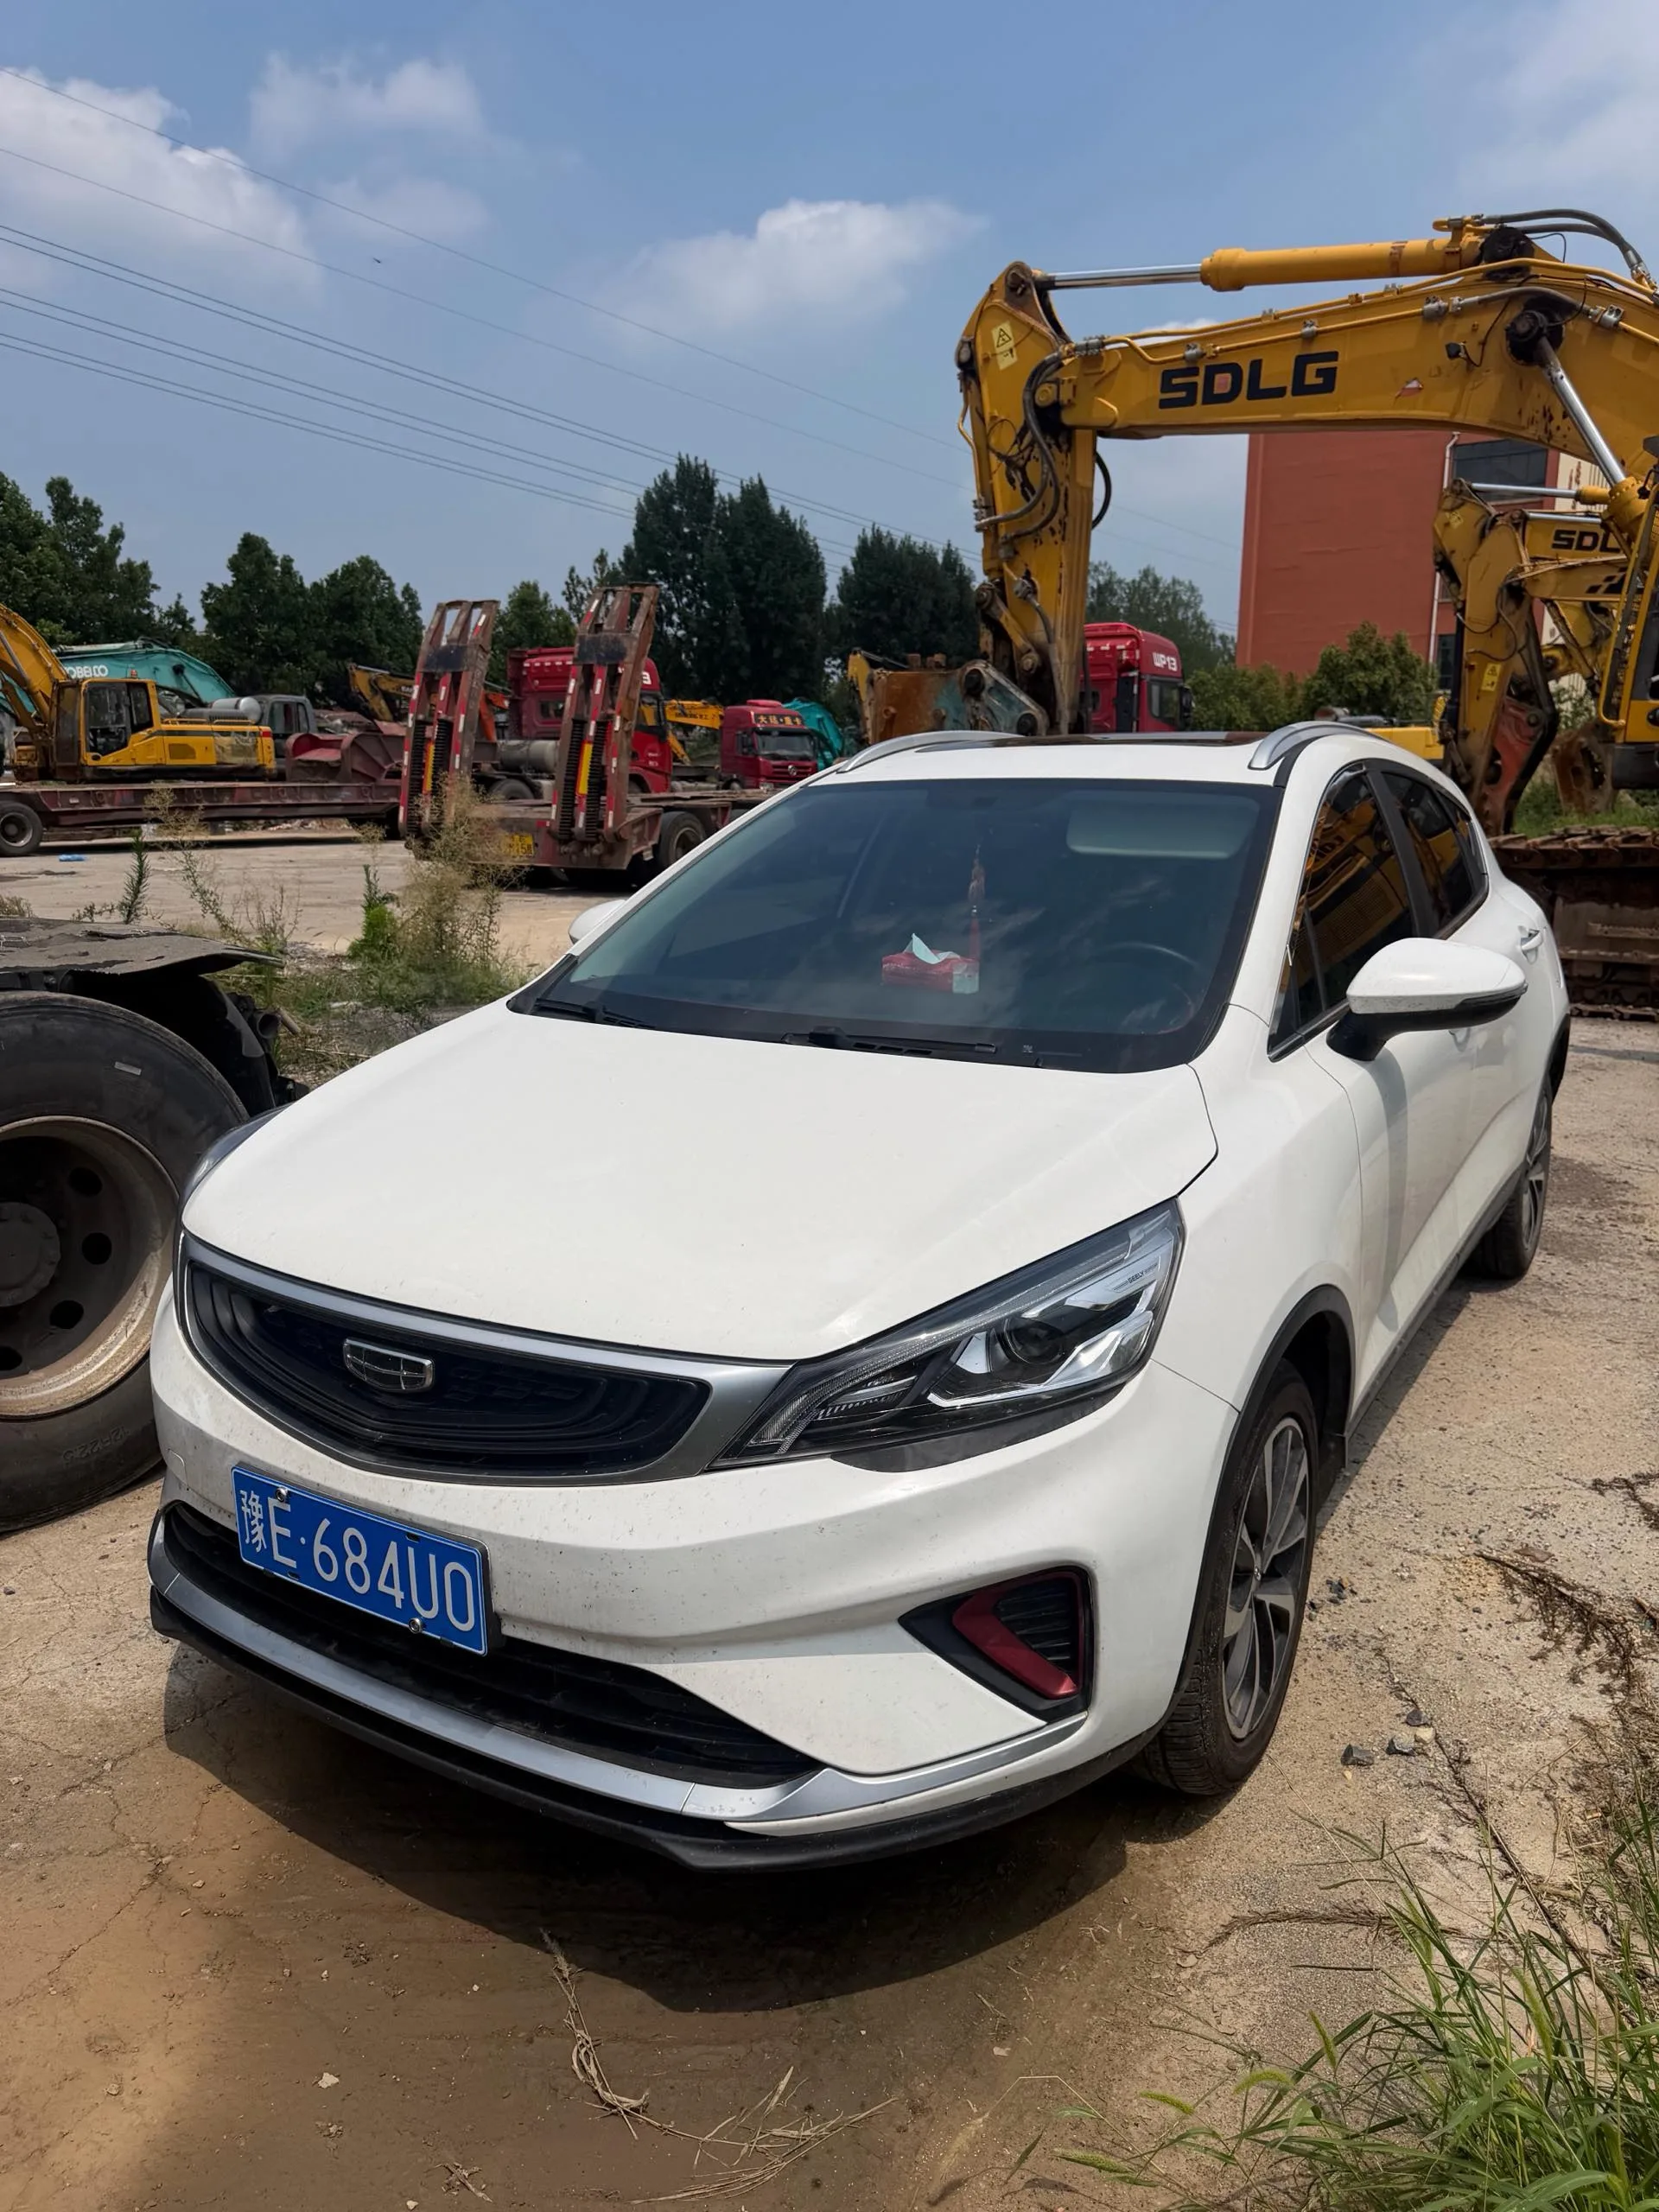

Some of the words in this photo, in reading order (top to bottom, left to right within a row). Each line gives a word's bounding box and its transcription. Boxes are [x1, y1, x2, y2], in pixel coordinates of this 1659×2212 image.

[1159, 351, 1339, 410] SDLG
[1152, 652, 1178, 671] WP13
[65, 664, 109, 679] OBELCO
[1128, 1270, 1145, 1283] GEELY
